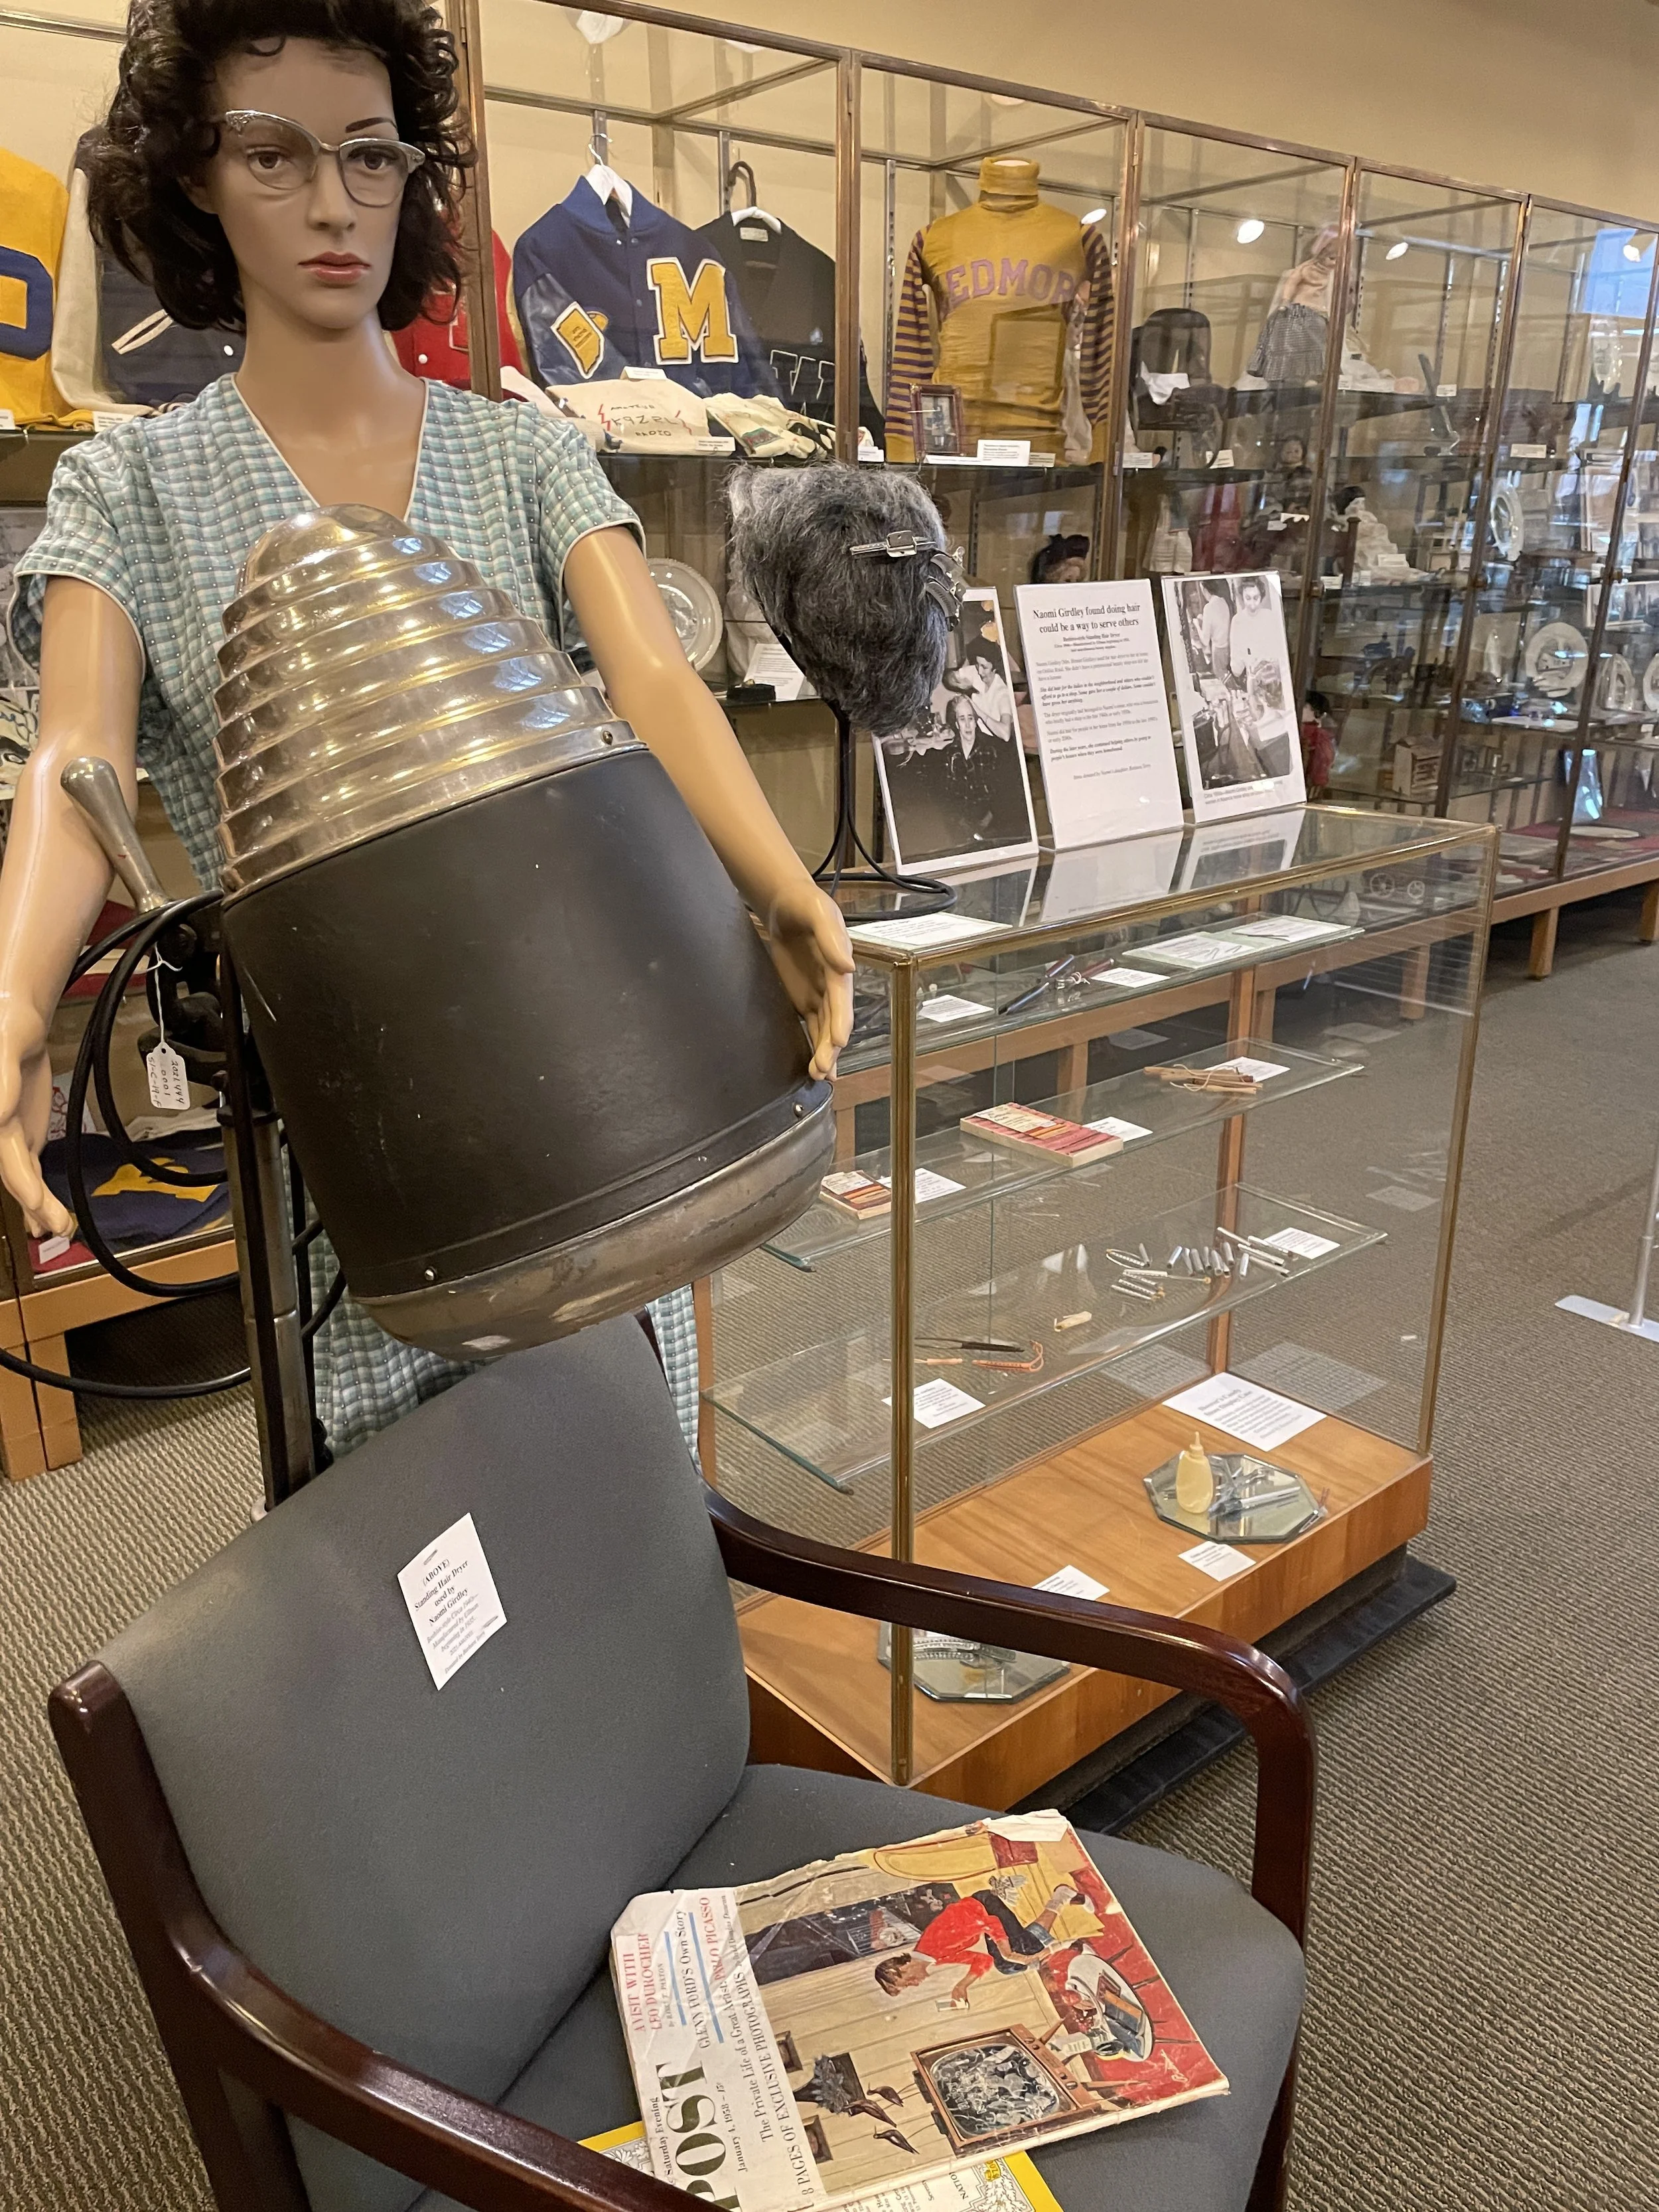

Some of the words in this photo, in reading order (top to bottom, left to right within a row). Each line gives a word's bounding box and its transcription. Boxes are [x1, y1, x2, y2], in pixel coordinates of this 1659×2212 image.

[943, 258, 1076, 308] EDMOR
[646, 257, 739, 365] M
[1033, 609, 1057, 619] Naomi
[1058, 607, 1084, 618] Girdley
[1086, 606, 1105, 616] found
[1107, 605, 1125, 614] doing
[1127, 603, 1140, 612] hair
[1039, 623, 1058, 633] could
[1060, 623, 1068, 631] be
[1076, 622, 1090, 631] way
[1118, 617, 1139, 626] others
[414, 1583, 438, 1611] Standing
[437, 1574, 452, 1590] Hair
[451, 1560, 469, 1578] Dryer
[422, 1558, 450, 1587] (ABOVE)
[429, 1605, 448, 1626] Naomi
[447, 1588, 469, 1609] Girdley
[434, 1592, 448, 1607] used
[447, 1586, 455, 1598] by
[675, 1910, 687, 1937] Story
[699, 1897, 718, 1944] PICASSO
[679, 1940, 690, 1964] Own
[709, 1948, 727, 1980] PABLO
[623, 1954, 637, 1990] WITH
[637, 1933, 658, 2006] DUROCHER
[681, 1967, 700, 2008] FORD'S
[627, 1996, 644, 2024] VISIT
[648, 2008, 662, 2030] LEO
[729, 2009, 743, 2039] Great
[733, 1971, 766, 2051] PHOTOGRAPHS
[692, 2010, 711, 2049] GLENN
[737, 2047, 748, 2057] of
[740, 2060, 755, 2079] Life
[759, 2051, 790, 2121] EXCLUSIVE
[650, 2097, 664, 2134] Evening
[721, 2103, 733, 2123] 1958
[749, 2081, 766, 2118] Private
[760, 2120, 774, 2142] The
[780, 2124, 796, 2142] OF
[659, 2136, 673, 2178] Saturday
[731, 2136, 749, 2172] January
[787, 2145, 811, 2185] PAGES
[949, 2171, 968, 2200] NATIO
